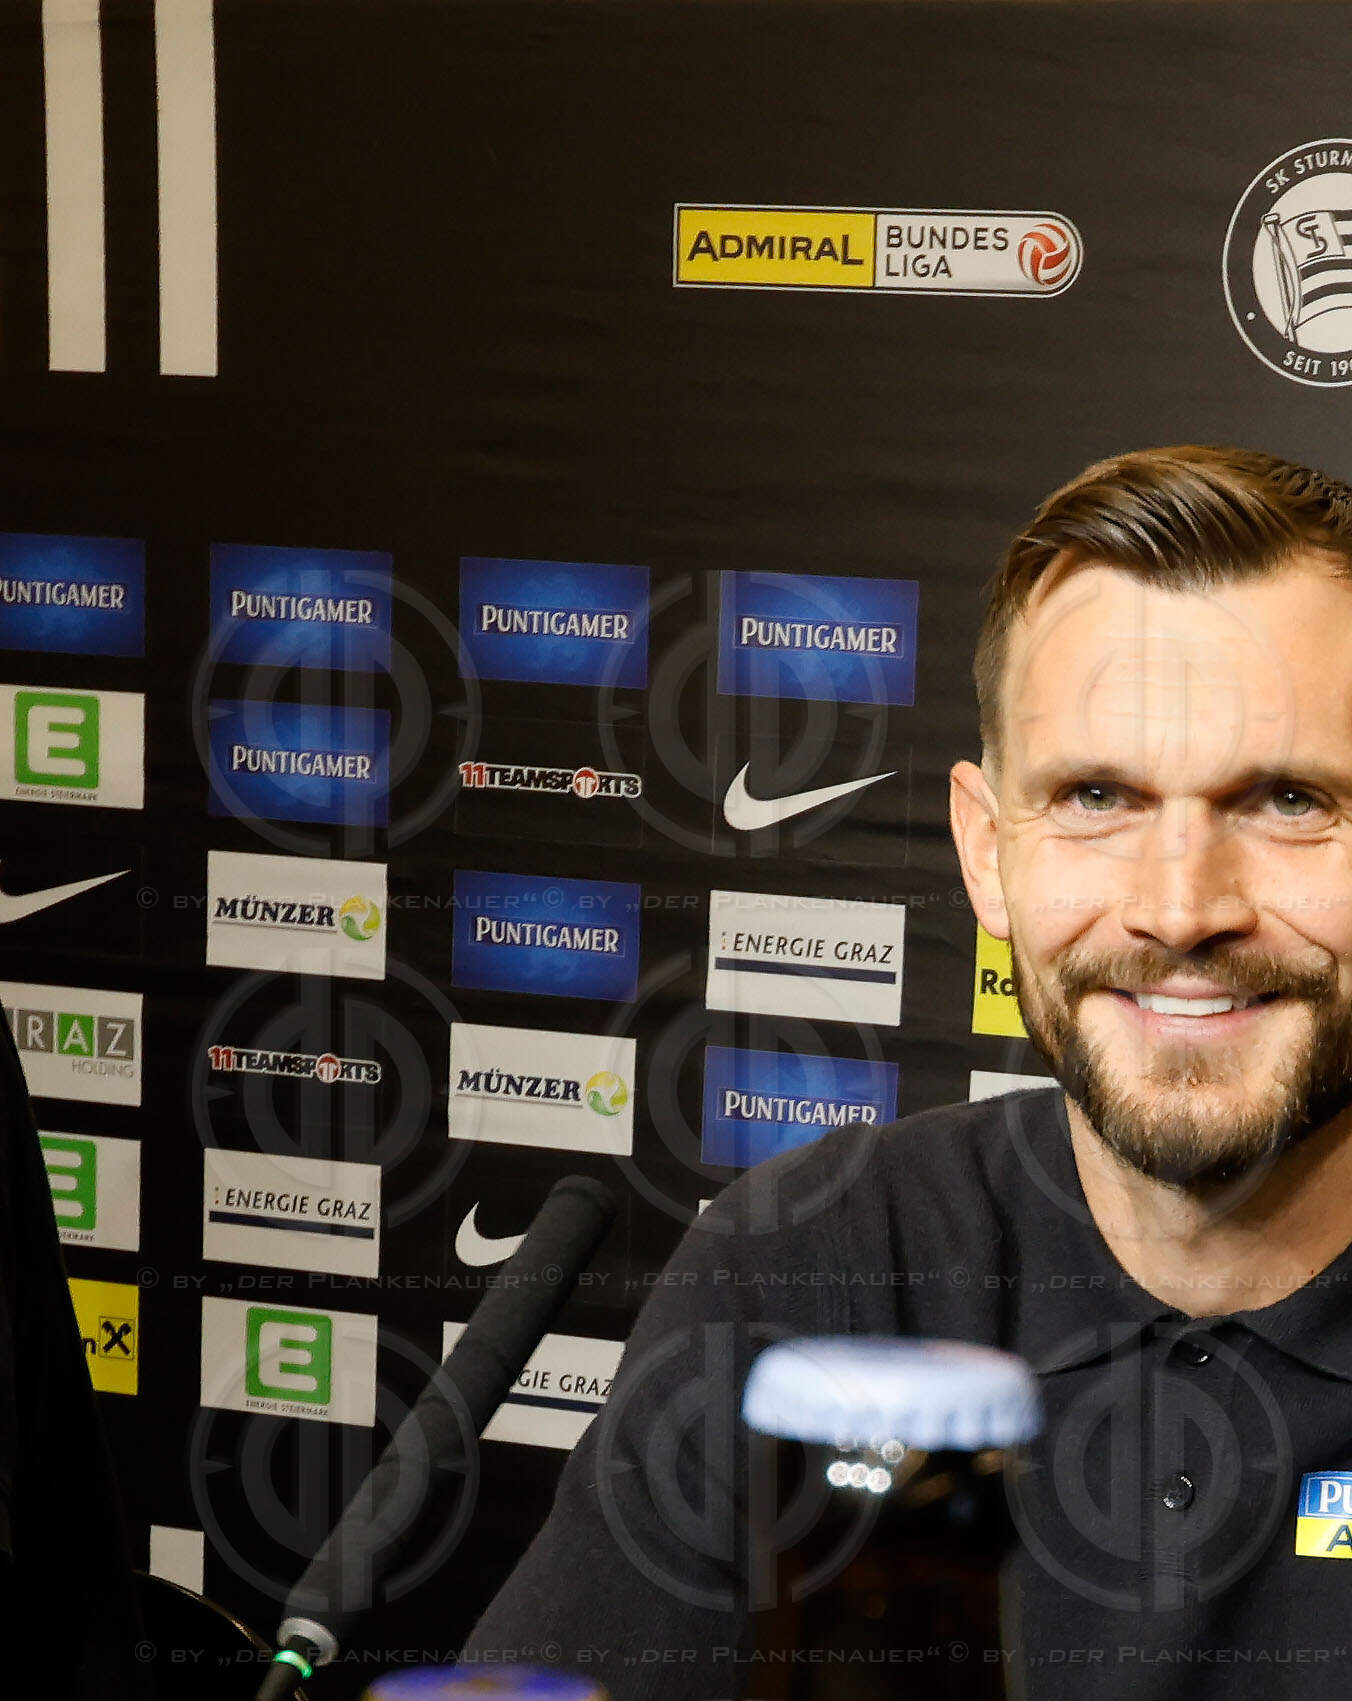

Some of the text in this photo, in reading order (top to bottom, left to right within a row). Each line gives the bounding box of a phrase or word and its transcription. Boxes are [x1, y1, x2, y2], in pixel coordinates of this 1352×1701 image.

[1266, 170, 1290, 194] SK
[687, 230, 865, 269] ADMIRAL
[885, 225, 1009, 252] BUNDES
[885, 254, 953, 280] LIGA
[1283, 351, 1322, 376] SEIT
[0, 579, 125, 610] UNTIGAMER
[231, 590, 373, 626] PUNTIGAMER
[481, 605, 630, 641] PUNTIGAMER
[740, 616, 898, 655] PUNTIGAMER
[232, 745, 372, 780] PUNTIGAMER
[215, 894, 336, 928] MÜNZER
[475, 916, 619, 954] PUNTIGAMER
[733, 931, 894, 966] ENERGIE GRAZ
[27, 1015, 127, 1057] RAZ
[455, 1067, 582, 1102] MÜNZER
[225, 1188, 372, 1222] ENERGIE GRAZ
